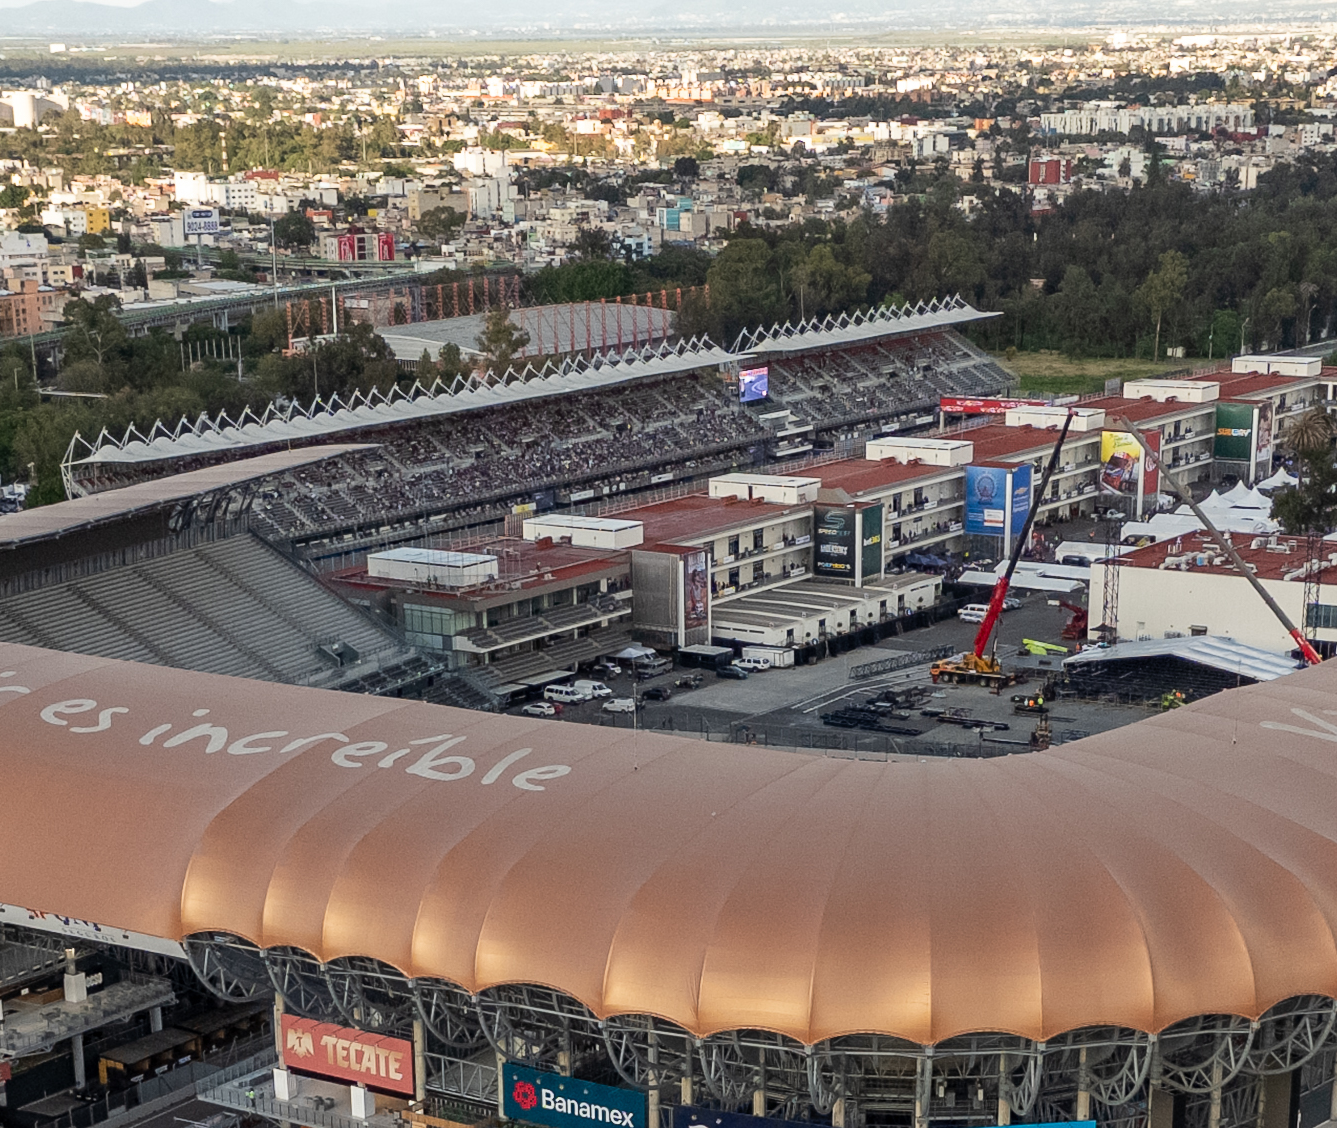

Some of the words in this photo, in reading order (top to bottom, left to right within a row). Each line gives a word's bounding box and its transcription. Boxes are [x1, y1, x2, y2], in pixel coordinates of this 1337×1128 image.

[40, 698, 130, 734] es
[319, 1034, 405, 1081] TECATE
[541, 1087, 634, 1128] Banamex
